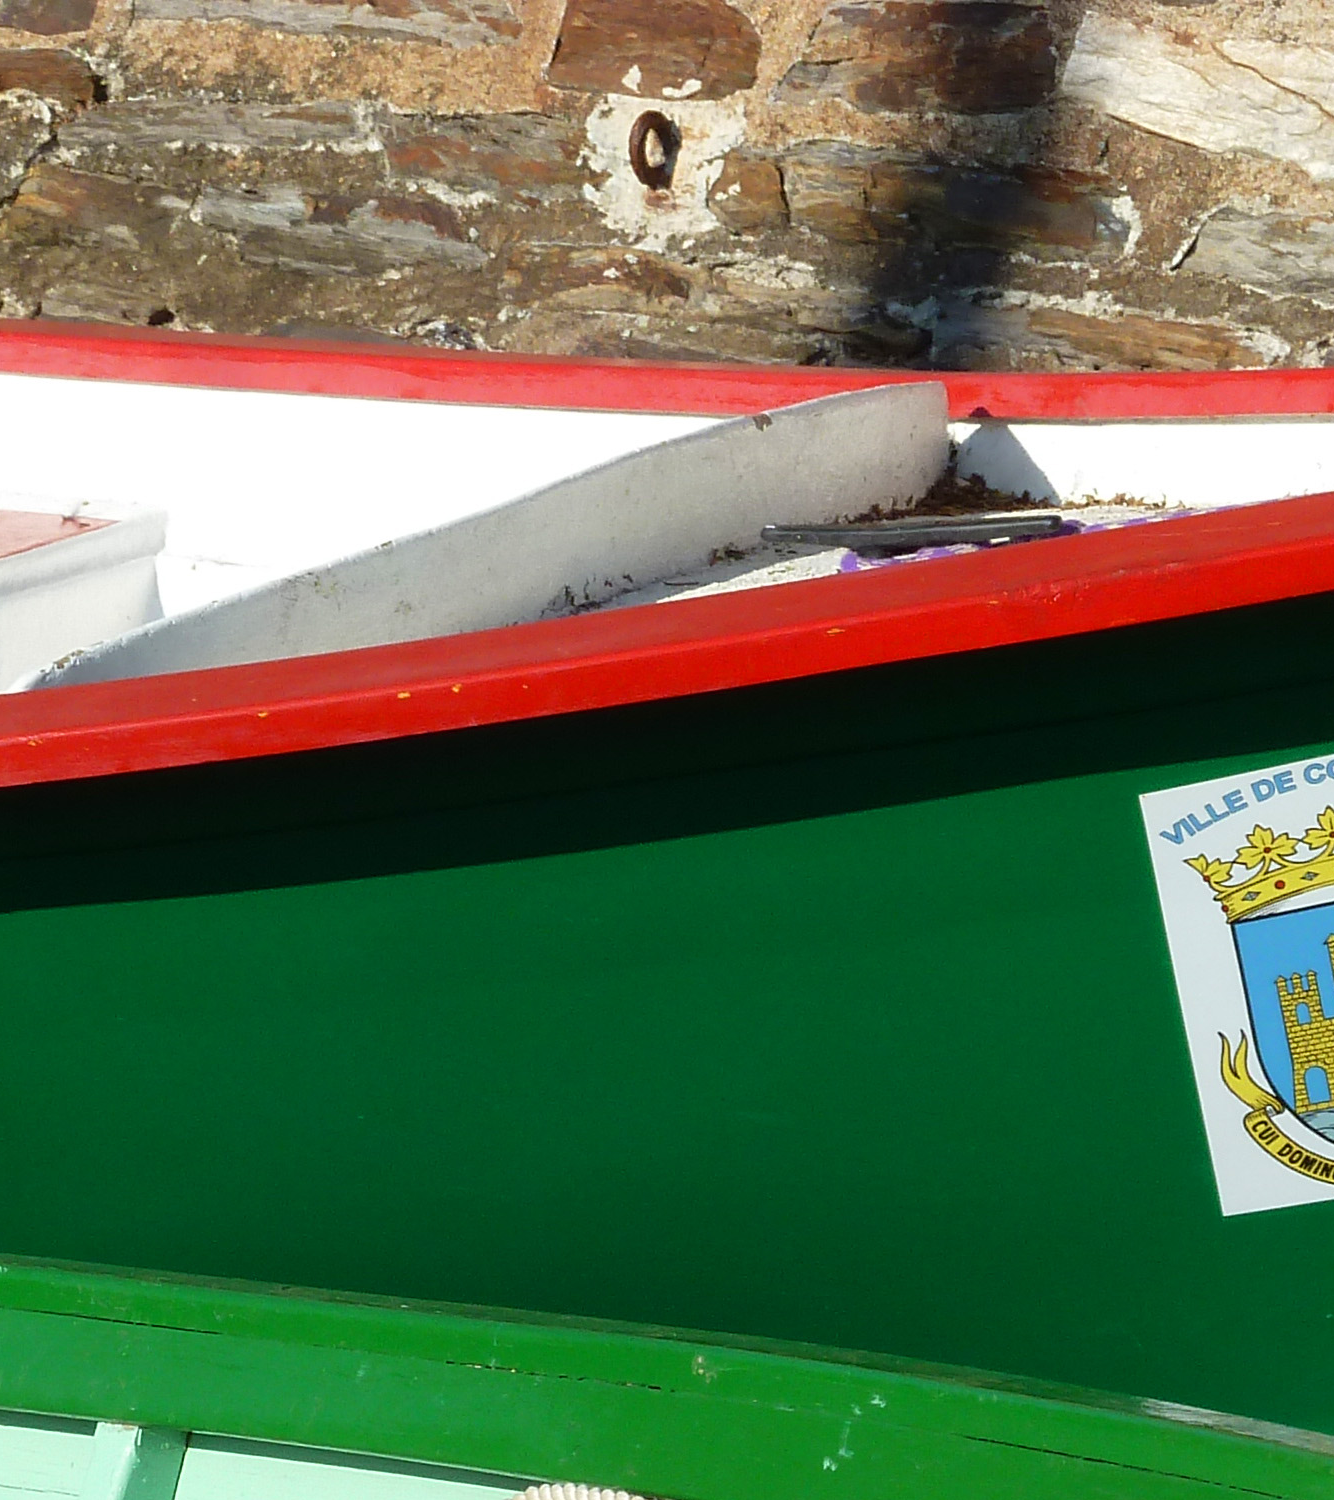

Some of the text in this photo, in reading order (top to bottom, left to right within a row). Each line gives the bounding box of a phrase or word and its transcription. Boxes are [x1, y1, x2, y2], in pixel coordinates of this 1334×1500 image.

[1160, 789, 1248, 846] VILLE
[1251, 770, 1297, 803] DE
[1252, 1119, 1280, 1148] CUI
